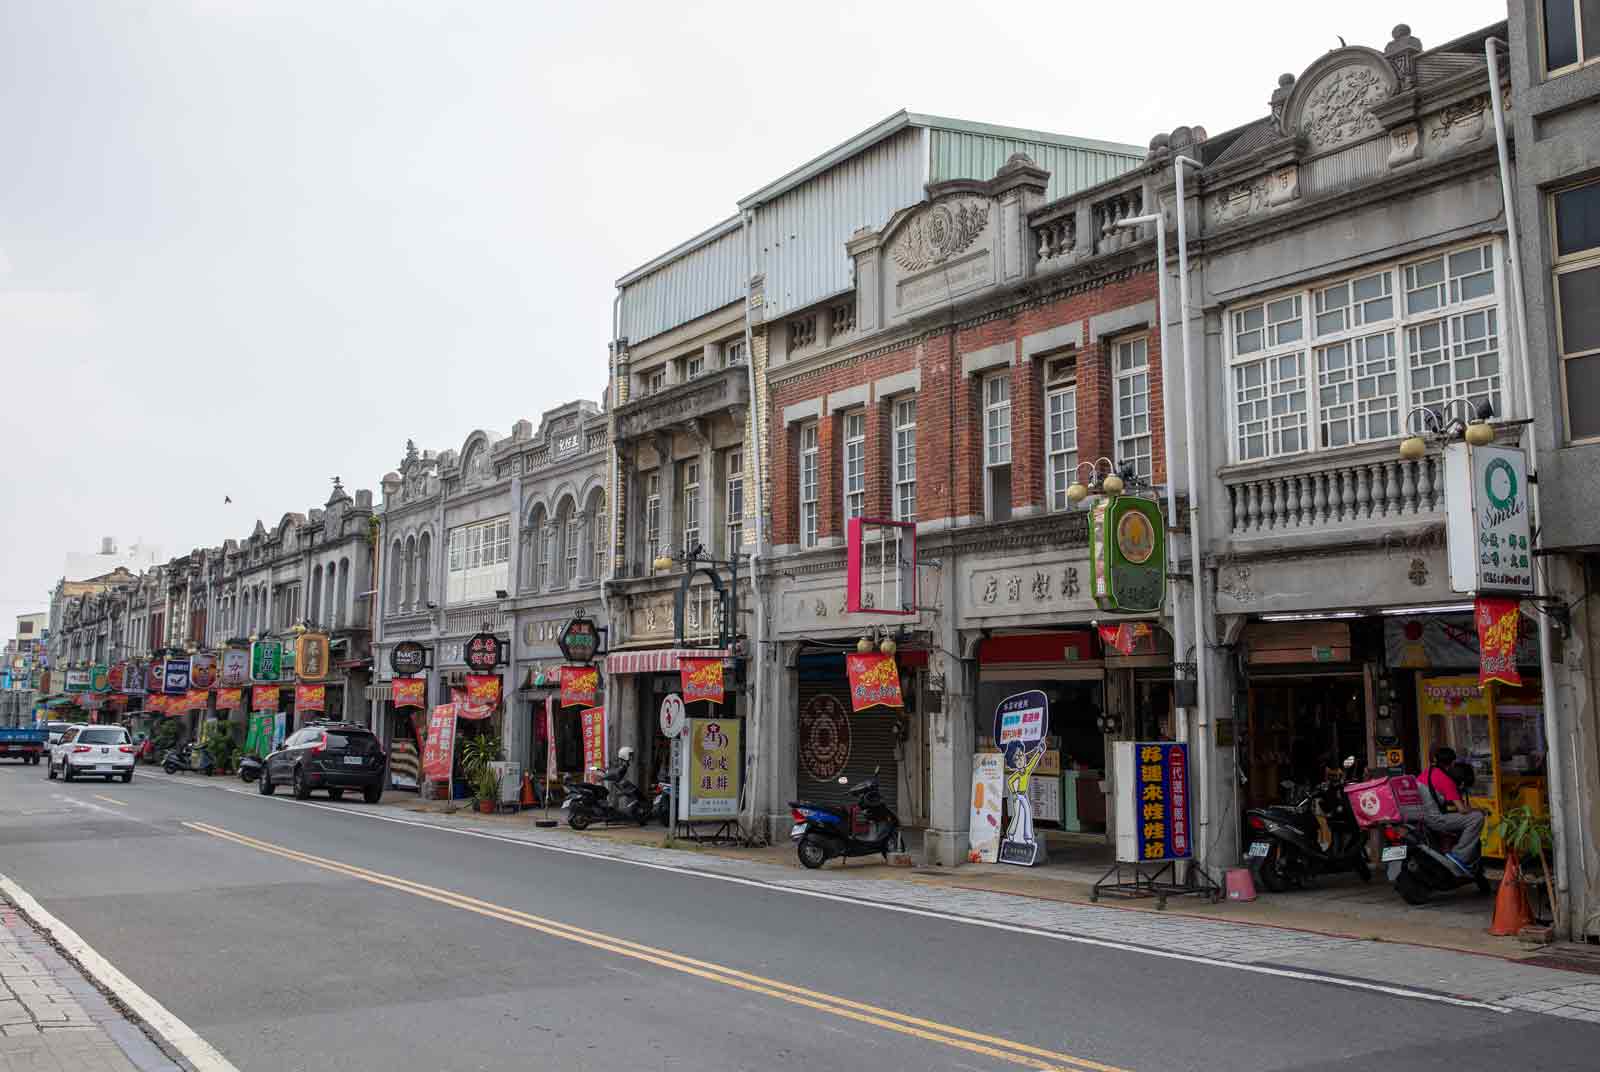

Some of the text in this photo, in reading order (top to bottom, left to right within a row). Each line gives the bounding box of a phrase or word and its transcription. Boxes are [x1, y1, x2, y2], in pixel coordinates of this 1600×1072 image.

[1427, 687, 1448, 697] TOY
[703, 755, 729, 771] 脆皮
[702, 775, 729, 791] 雞排
